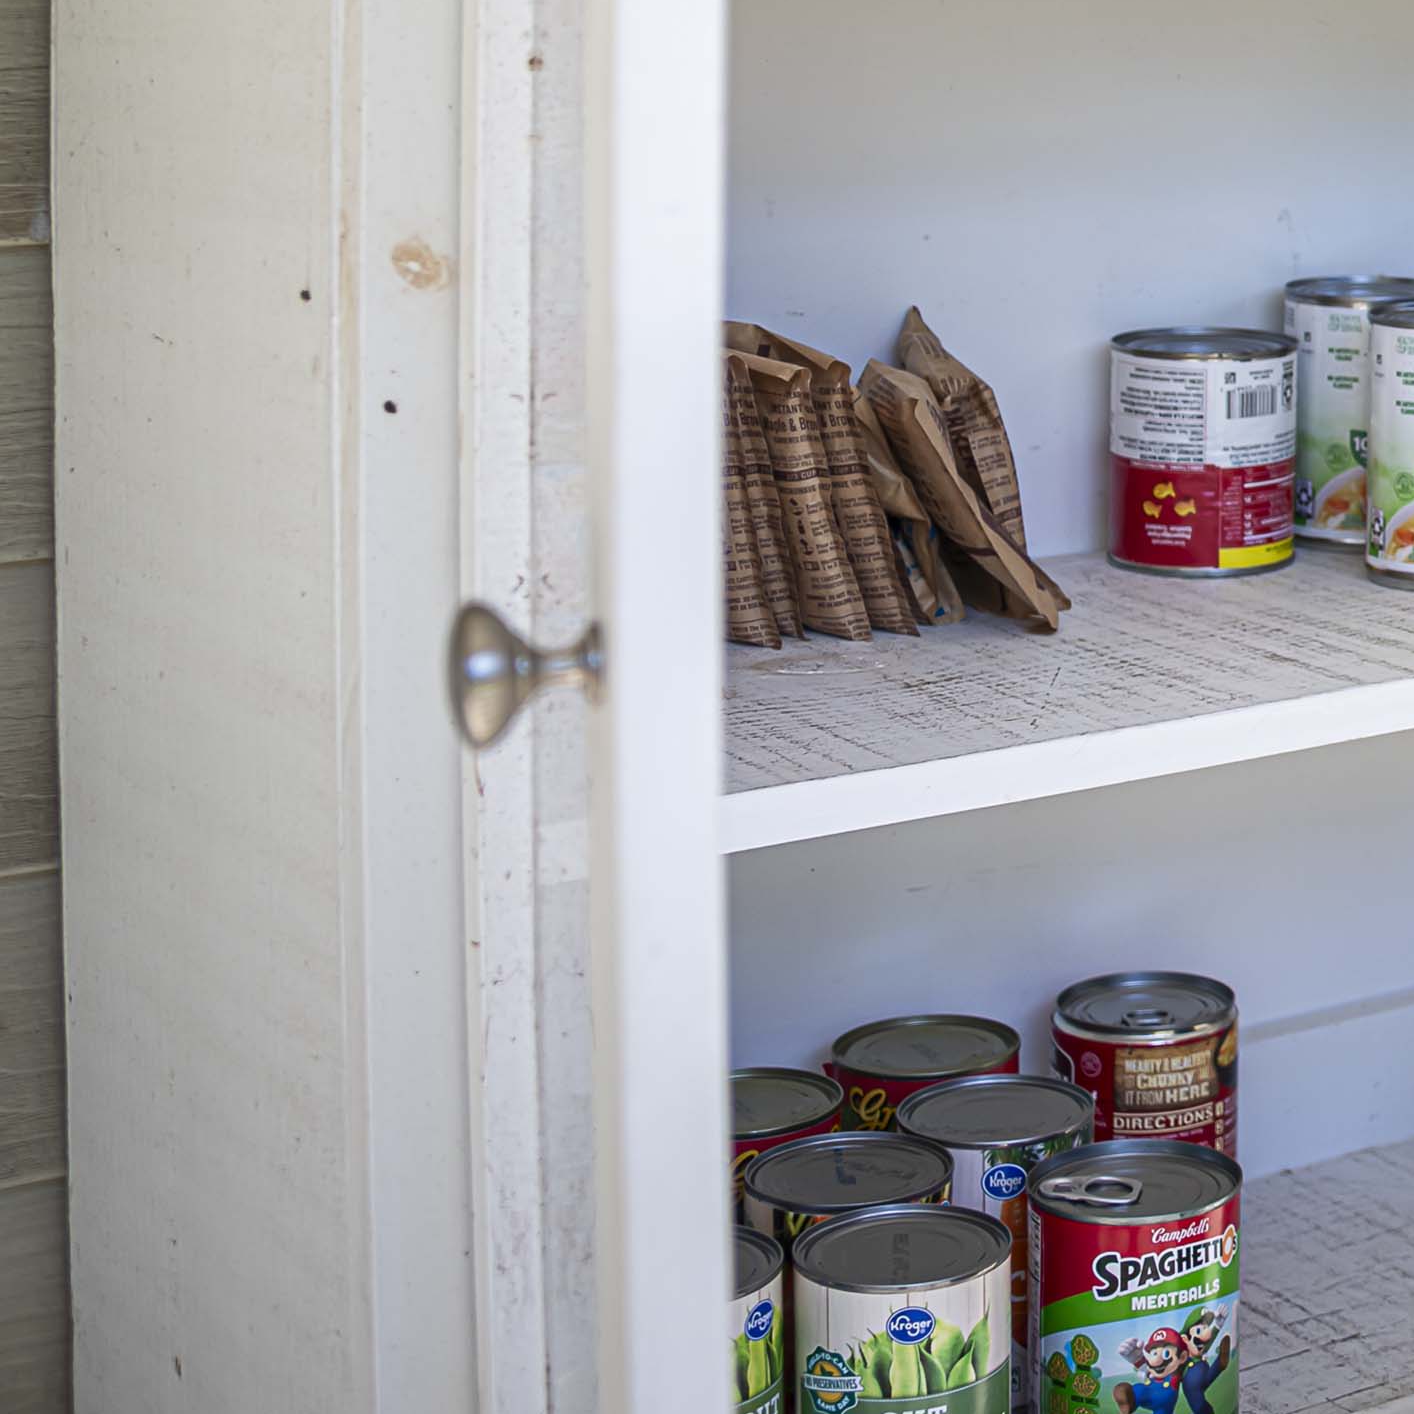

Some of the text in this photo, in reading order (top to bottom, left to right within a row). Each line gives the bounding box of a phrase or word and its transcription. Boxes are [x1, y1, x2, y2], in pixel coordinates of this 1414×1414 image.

[1136, 1070, 1195, 1090] CHUNKY
[1135, 1090, 1164, 1106] FROM
[1165, 1082, 1210, 1104] HERE
[1114, 1105, 1213, 1130] DIRECTIONS
[989, 1170, 1023, 1193] Kroger
[1151, 1217, 1210, 1244] Campbell's
[1131, 1278, 1220, 1311] MEATBALLS
[748, 1309, 774, 1330] Kroger
[890, 1315, 932, 1337] Kroger
[812, 1375, 859, 1390] PRESERVATIVES
[817, 1395, 850, 1413] SAME DAY
